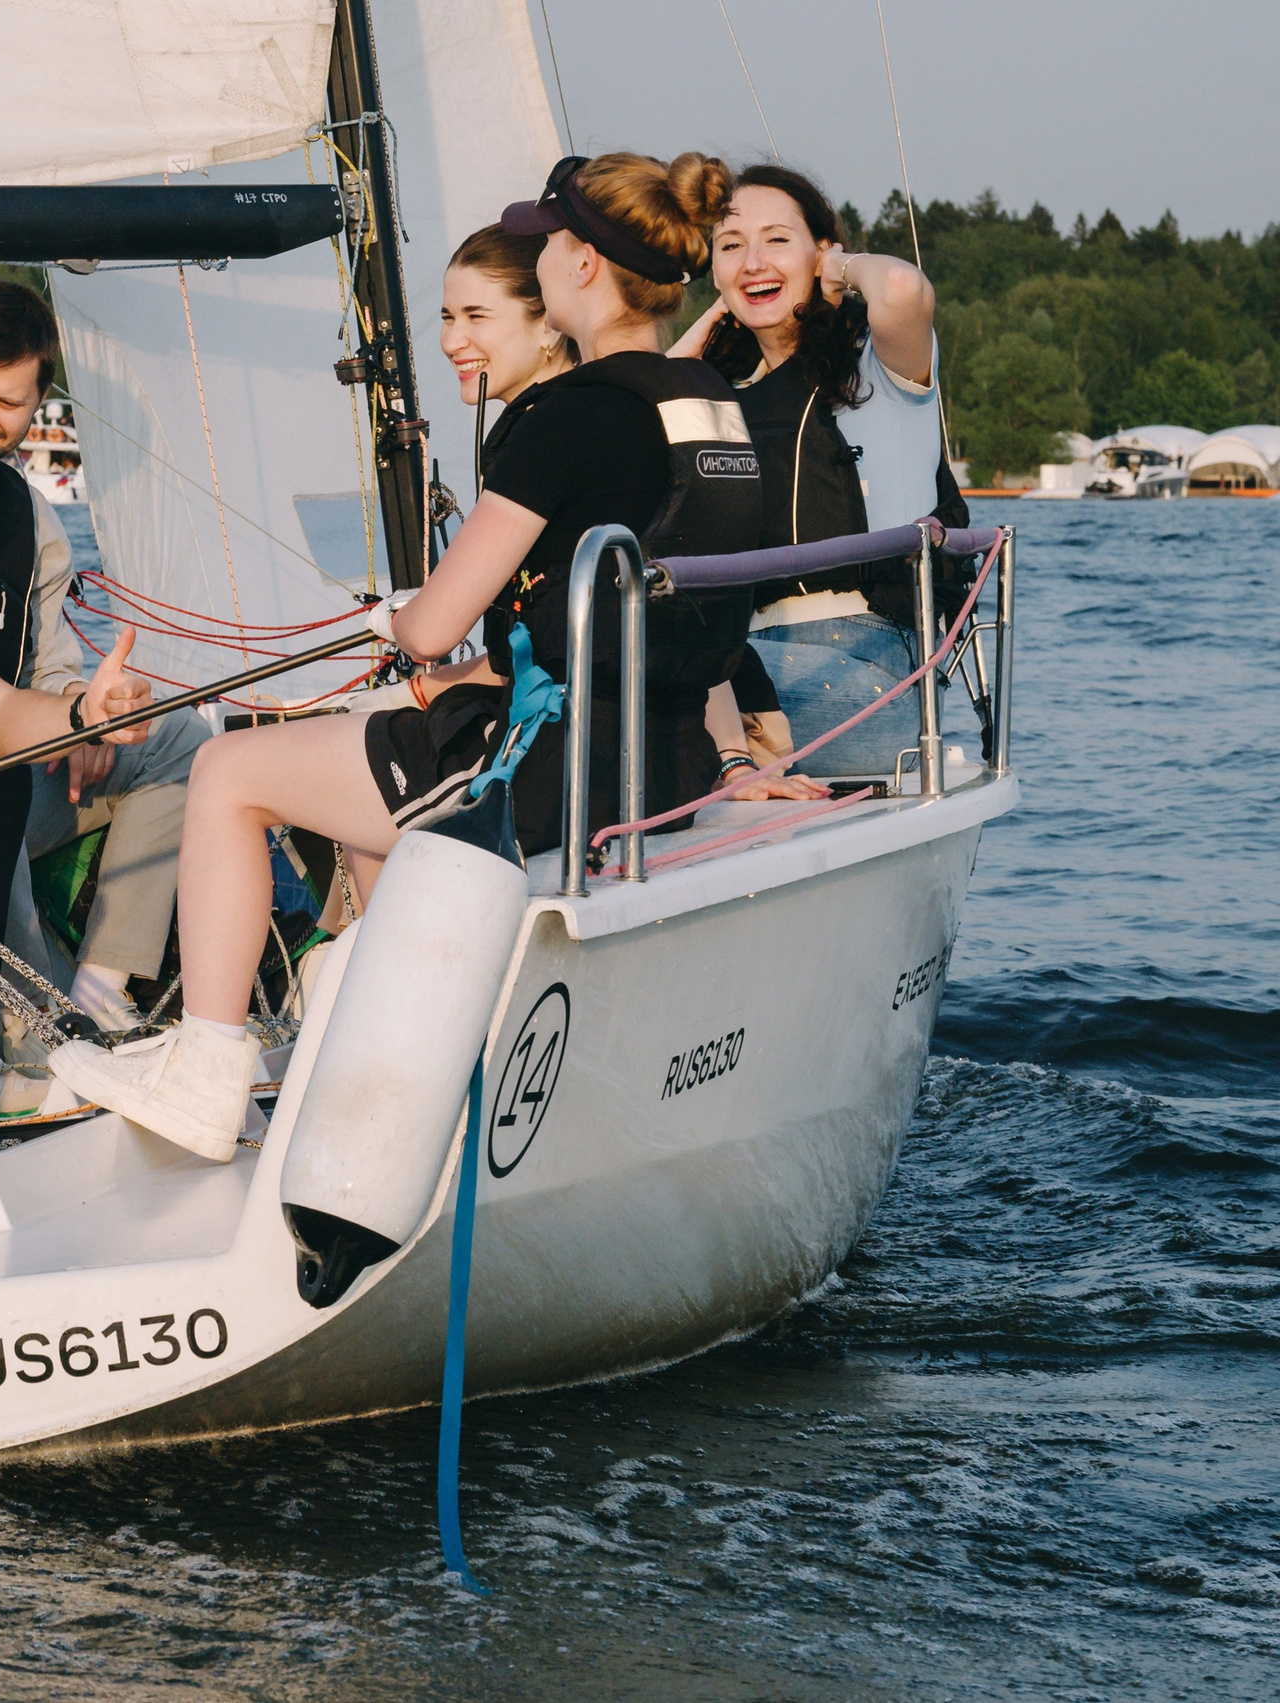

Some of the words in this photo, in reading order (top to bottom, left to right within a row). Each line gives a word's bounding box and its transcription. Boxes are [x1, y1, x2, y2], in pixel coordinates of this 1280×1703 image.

[702, 456, 757, 471] ИНСТРУКТОР
[892, 955, 937, 1011] EXEED
[497, 1031, 560, 1127] 14
[661, 1027, 745, 1101] RUS6130
